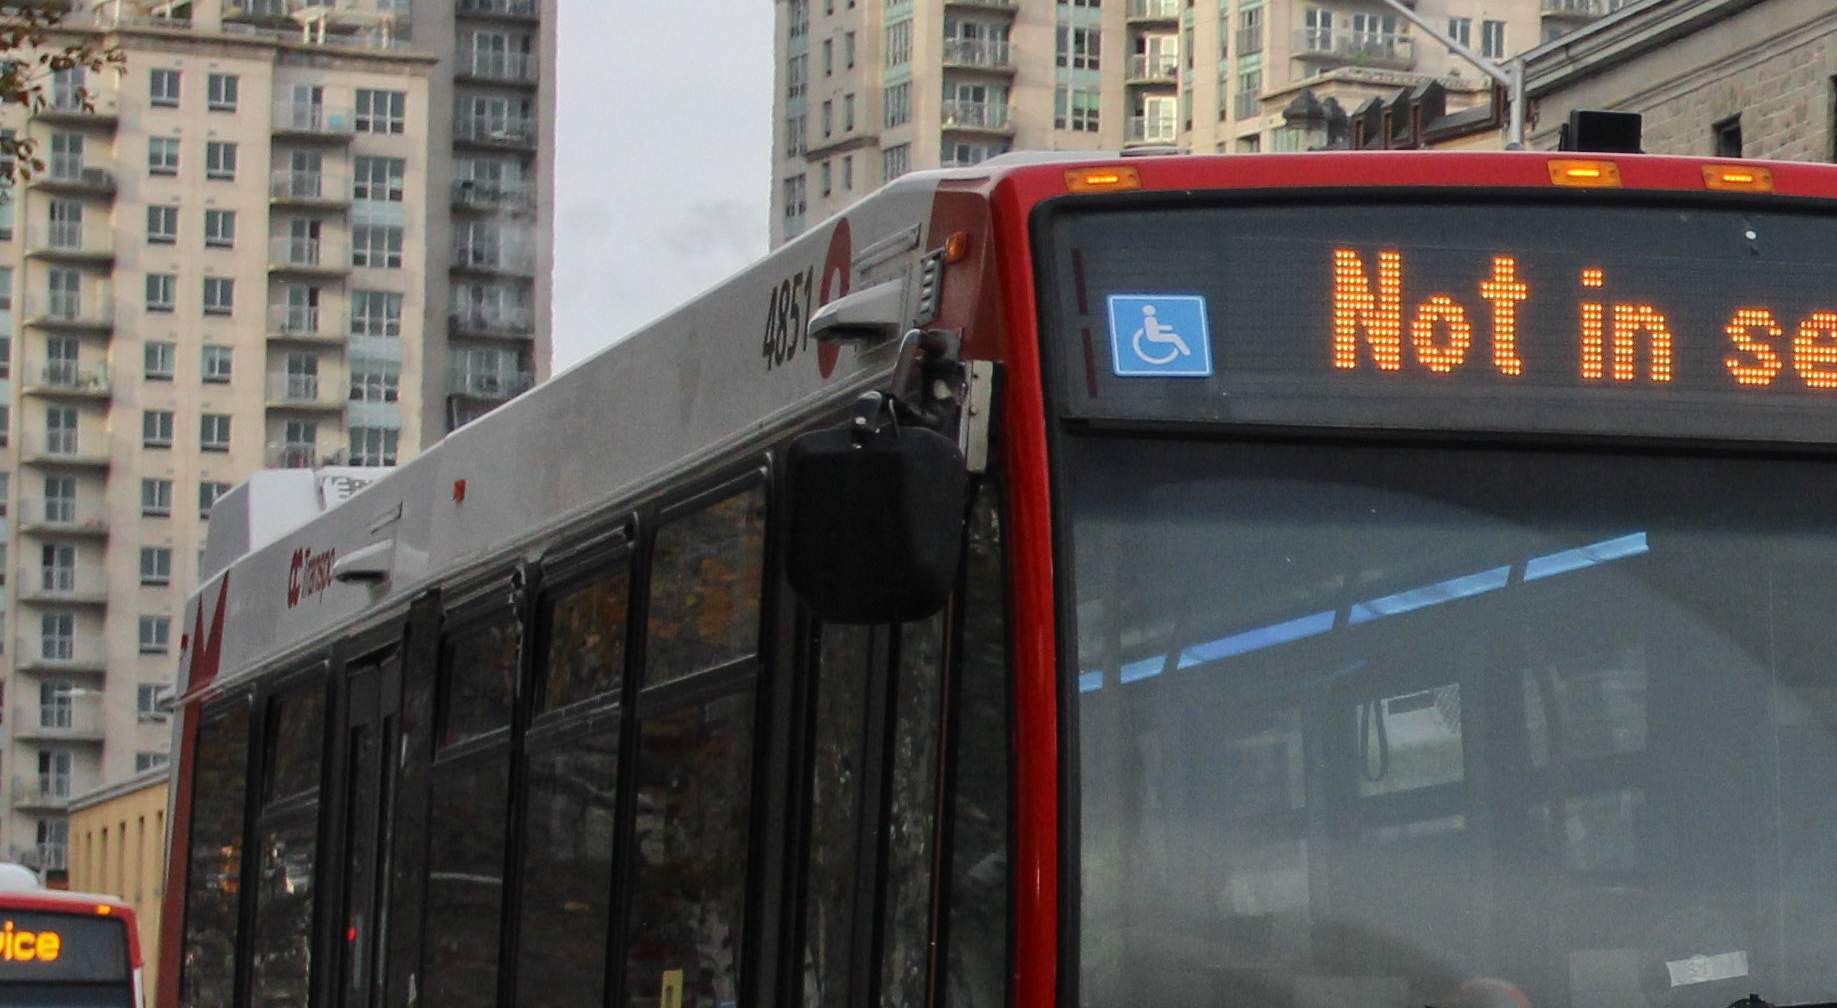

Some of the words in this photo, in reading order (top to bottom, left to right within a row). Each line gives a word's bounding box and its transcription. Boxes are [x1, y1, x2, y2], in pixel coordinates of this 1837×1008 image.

[762, 265, 814, 371] 4851
[1333, 249, 1528, 377] Not
[1581, 268, 1672, 384] in
[0, 921, 61, 961] ice
